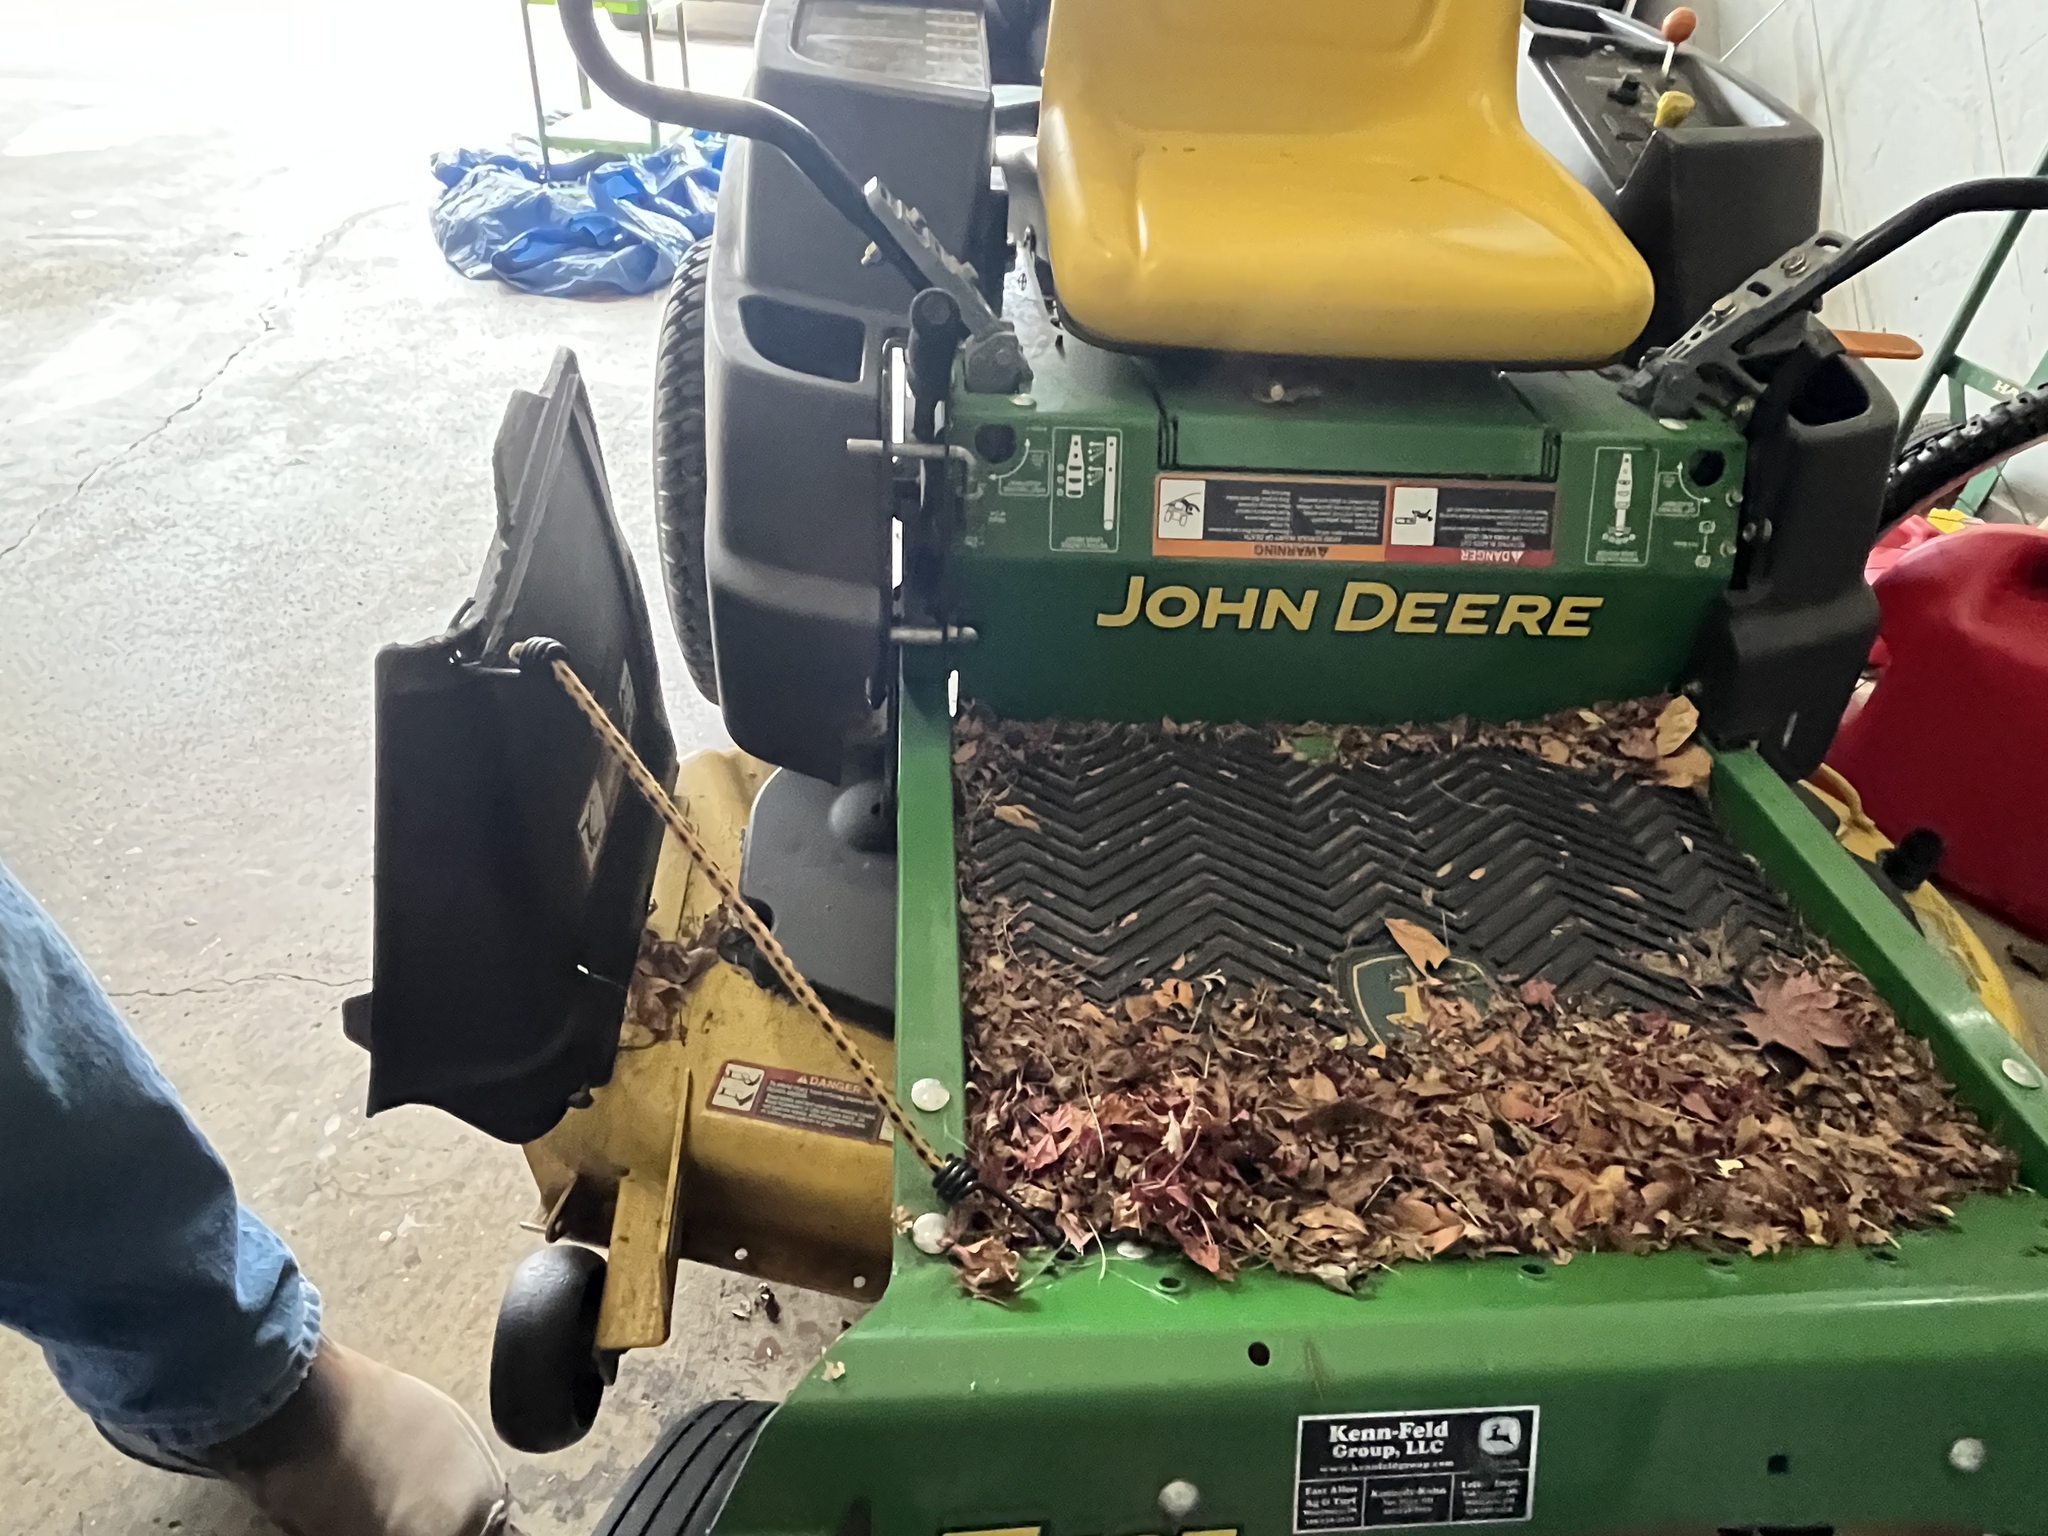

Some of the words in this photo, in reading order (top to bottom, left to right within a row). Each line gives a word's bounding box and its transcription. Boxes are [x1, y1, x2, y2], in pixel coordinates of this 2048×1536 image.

[1253, 545, 1317, 557] WARNING
[1460, 549, 1511, 562] DANGER
[1096, 575, 1320, 631] JOHN
[1333, 581, 1605, 637] DEERE
[808, 1076, 863, 1094] DANGER
[1329, 1421, 1448, 1443] Kenn-Feld
[1332, 1444, 1400, 1459] Group,
[1405, 1440, 1445, 1456] LLC
